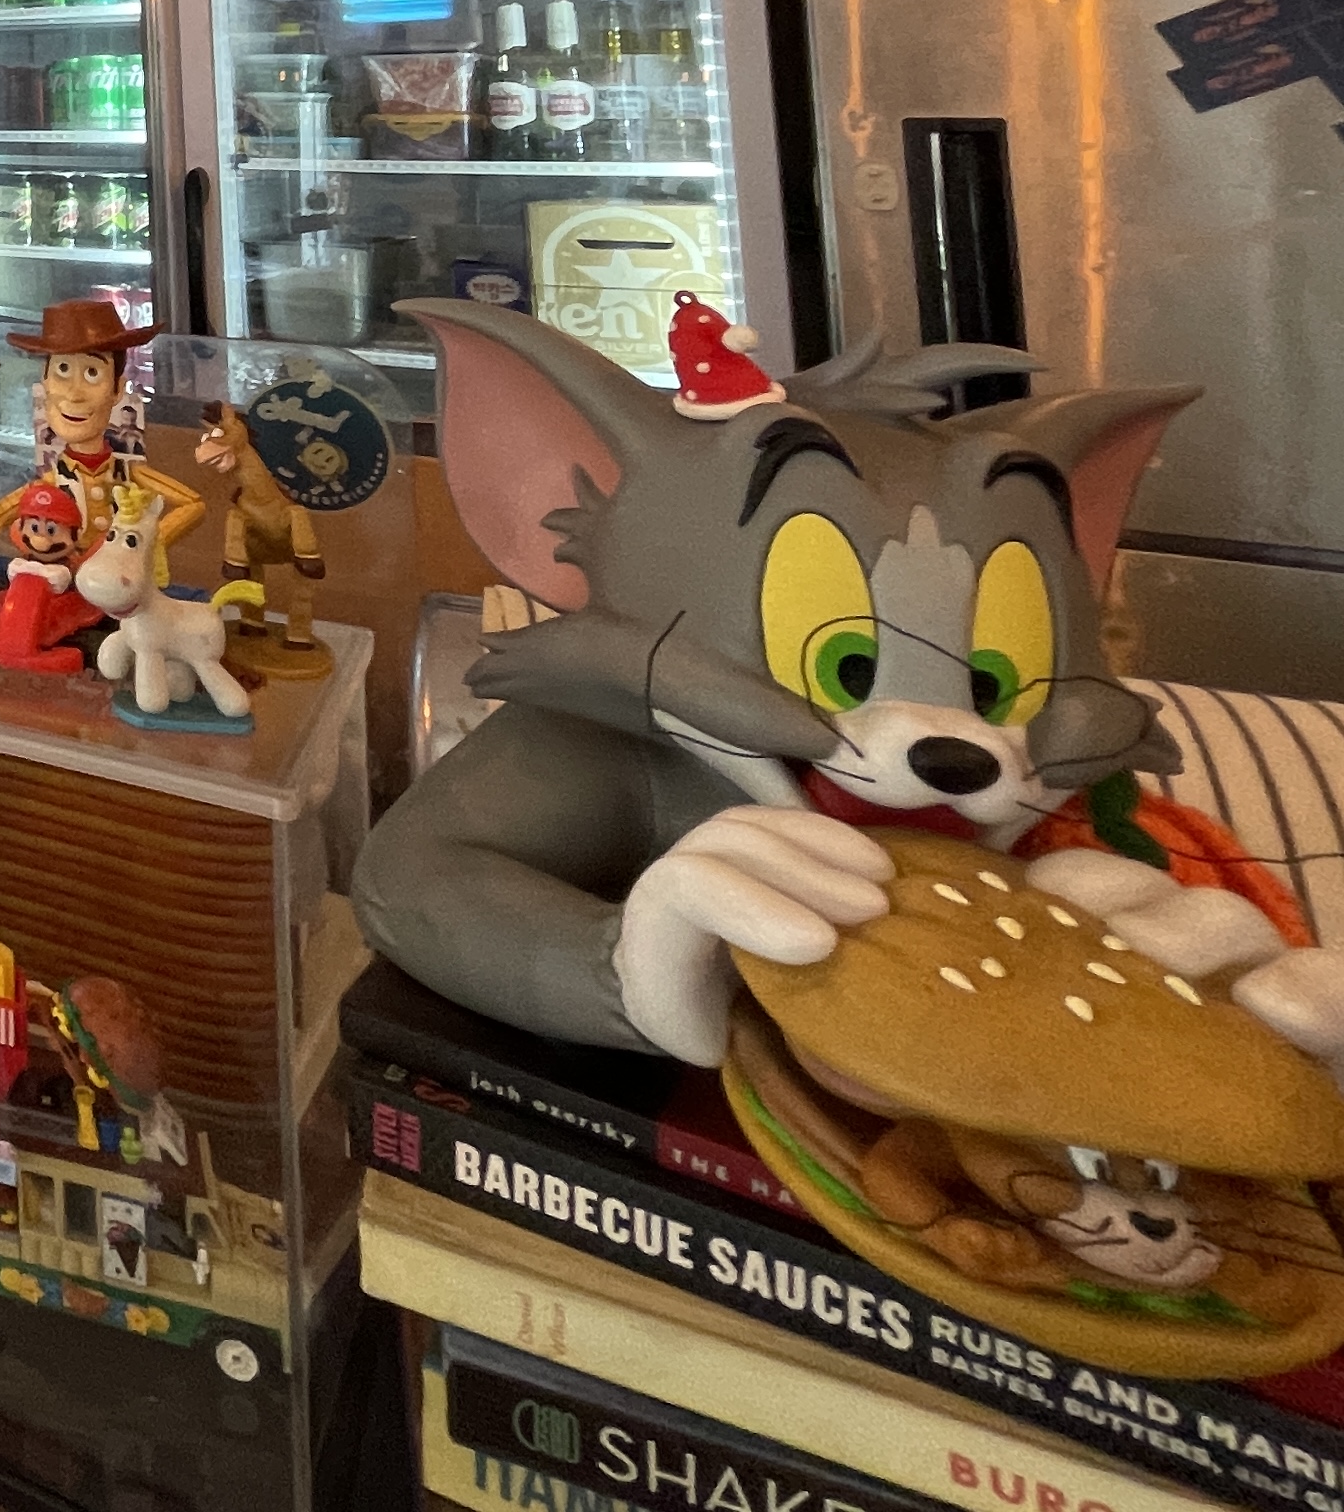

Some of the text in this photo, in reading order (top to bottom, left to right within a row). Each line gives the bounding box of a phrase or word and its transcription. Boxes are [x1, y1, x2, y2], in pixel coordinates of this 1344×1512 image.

[454, 1140, 697, 1271] BARBECUE
[706, 1235, 914, 1352] SAUCES
[929, 1314, 1344, 1490] RUBS AND MARI
[948, 1450, 1116, 1512] BUR
